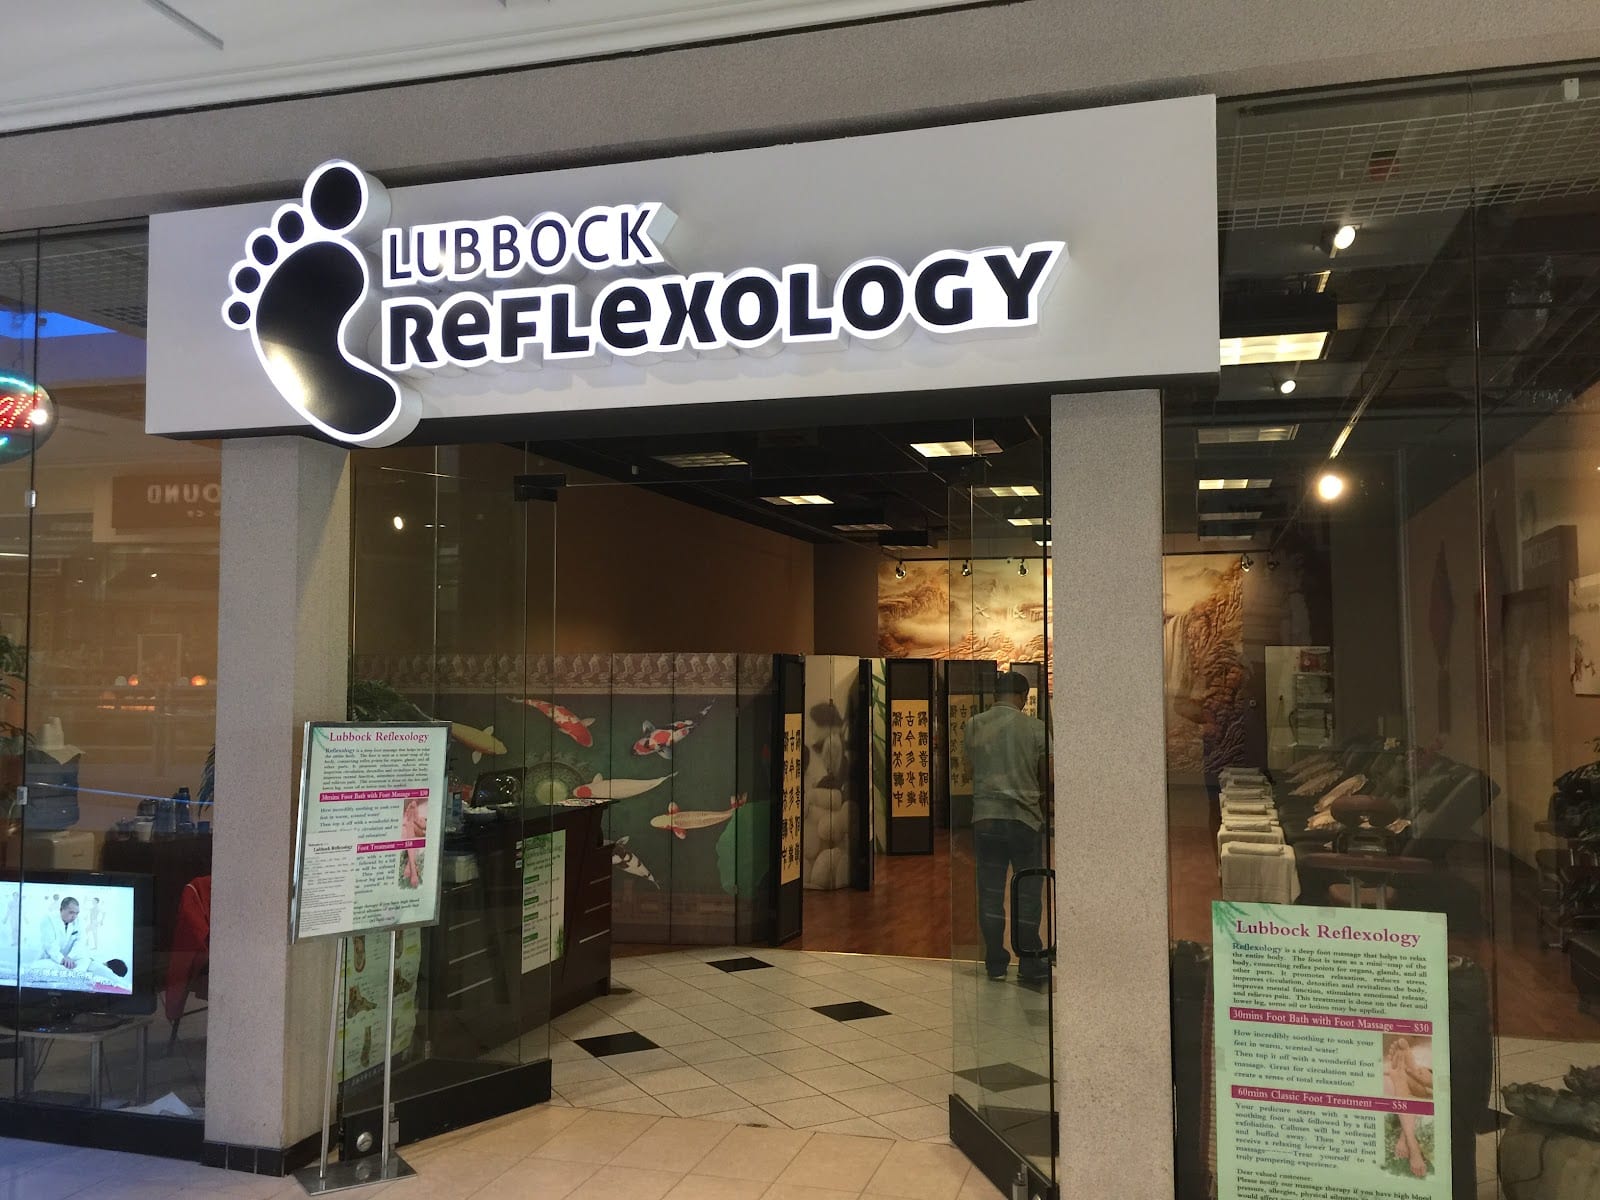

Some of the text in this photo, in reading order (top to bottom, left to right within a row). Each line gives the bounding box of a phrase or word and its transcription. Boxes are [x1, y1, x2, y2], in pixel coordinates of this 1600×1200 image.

[389, 205, 654, 280] LUBBOCK
[329, 732, 428, 742] Lubbock Reflexology
[1235, 919, 1421, 948] Lubbock Reflexology
[1232, 942, 1281, 953] Reflexology
[1232, 1009, 1429, 1033] 30mins Foot Bath with Foot Massage $30
[1253, 1030, 1288, 1040] incredibly
[1292, 1033, 1324, 1043] soothing
[1238, 1087, 1407, 1110] 60mins Classic Foot Treatment $58
